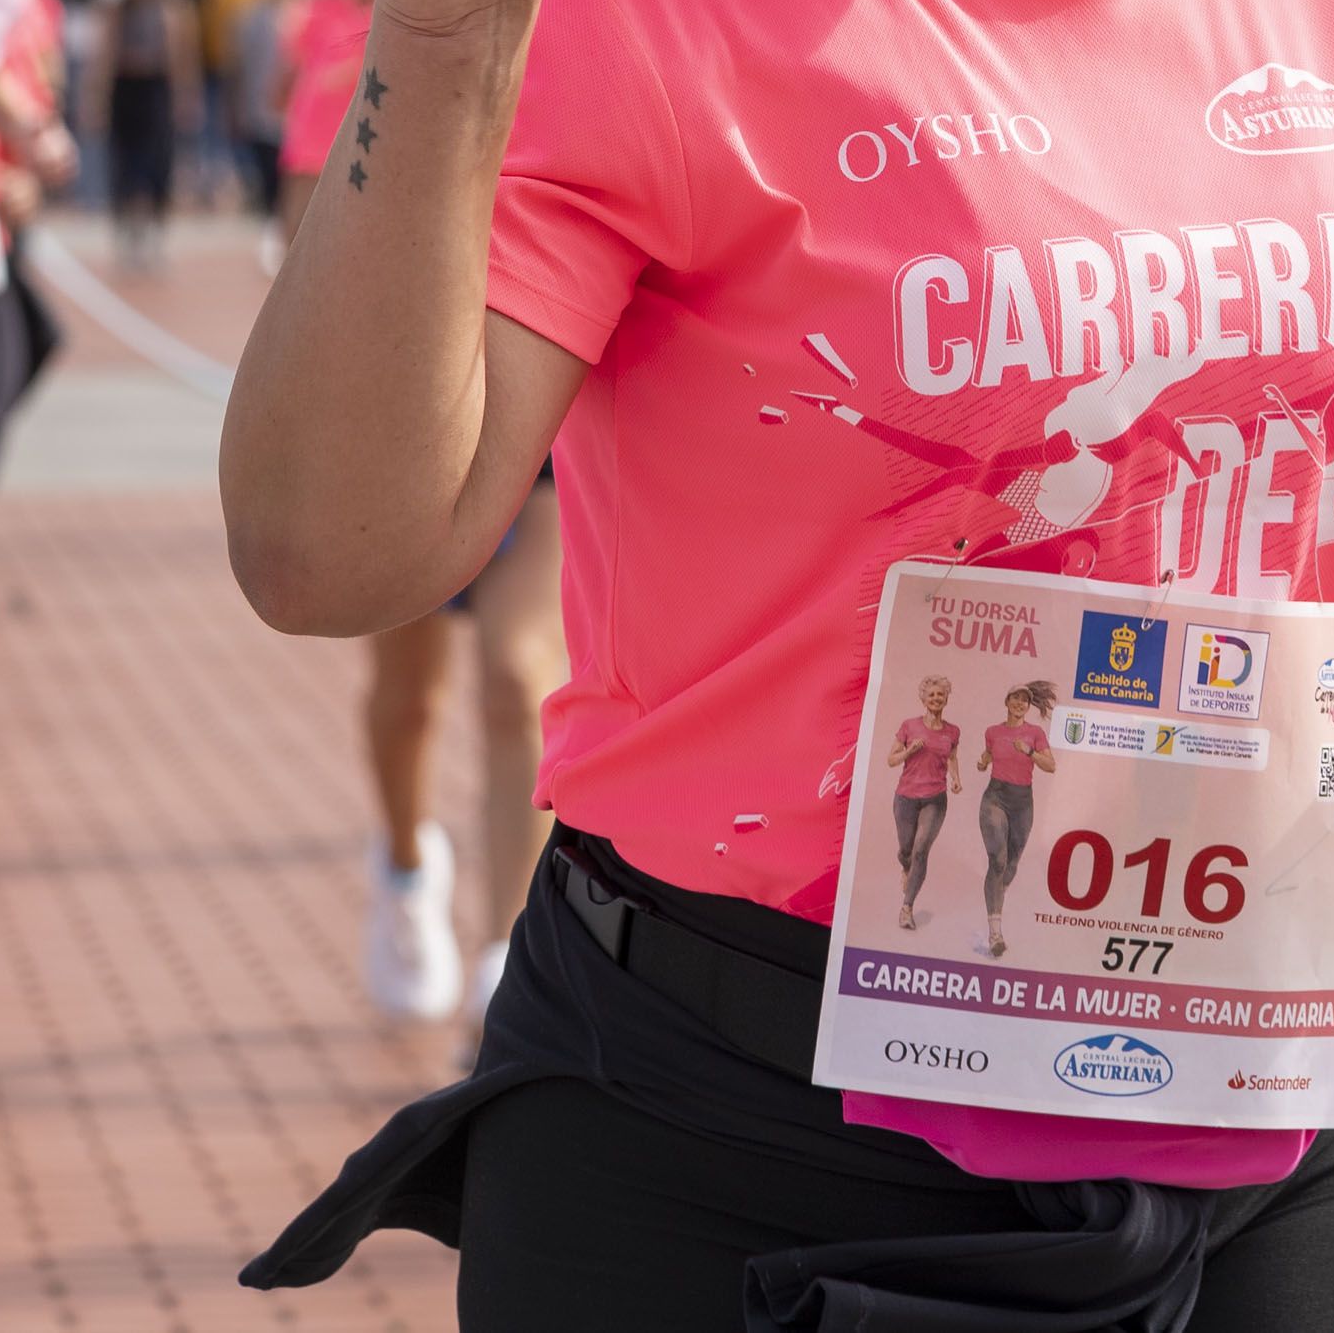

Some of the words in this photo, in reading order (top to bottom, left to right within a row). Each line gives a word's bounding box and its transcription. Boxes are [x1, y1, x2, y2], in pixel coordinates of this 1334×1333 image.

[838, 113, 1052, 182] OYSHO
[931, 596, 955, 614] TU
[961, 600, 1040, 625] DORSAL
[929, 617, 1037, 658] SUMA
[1087, 672, 1130, 688] Cabildo
[1133, 677, 1147, 689] de
[1081, 684, 1108, 696] Gran
[1110, 686, 1154, 702] Canaria
[1188, 685, 1224, 699] INSTITUTO
[1226, 690, 1254, 701] INSULAR
[1201, 700, 1250, 713] DEPORTES
[1091, 723, 1145, 735] Ayuntamiento
[1119, 733, 1144, 743] Palmas
[1099, 739, 1115, 747] Gran
[1117, 741, 1143, 751] Canaria
[1047, 830, 1249, 924] 016
[1035, 913, 1095, 928] TELÉFONO
[1098, 920, 1157, 934] VIOLENCIA
[1161, 926, 1175, 936] DE
[1178, 926, 1224, 940] GÉNERO
[1101, 936, 1174, 975] 577
[857, 962, 982, 1003] CARRERA
[992, 979, 1028, 1008] DE
[1035, 984, 1066, 1011] LA
[1075, 987, 1161, 1020] MUJER
[1185, 997, 1252, 1027] GRAN
[1258, 1001, 1334, 1029] CANARIA
[884, 1039, 989, 1073] OYSHO
[1083, 1052, 1119, 1062] CENTRAL
[1123, 1055, 1162, 1066] LECHERA
[1062, 1053, 1163, 1084] ASTURIANA
[1248, 1074, 1312, 1091] Santander
